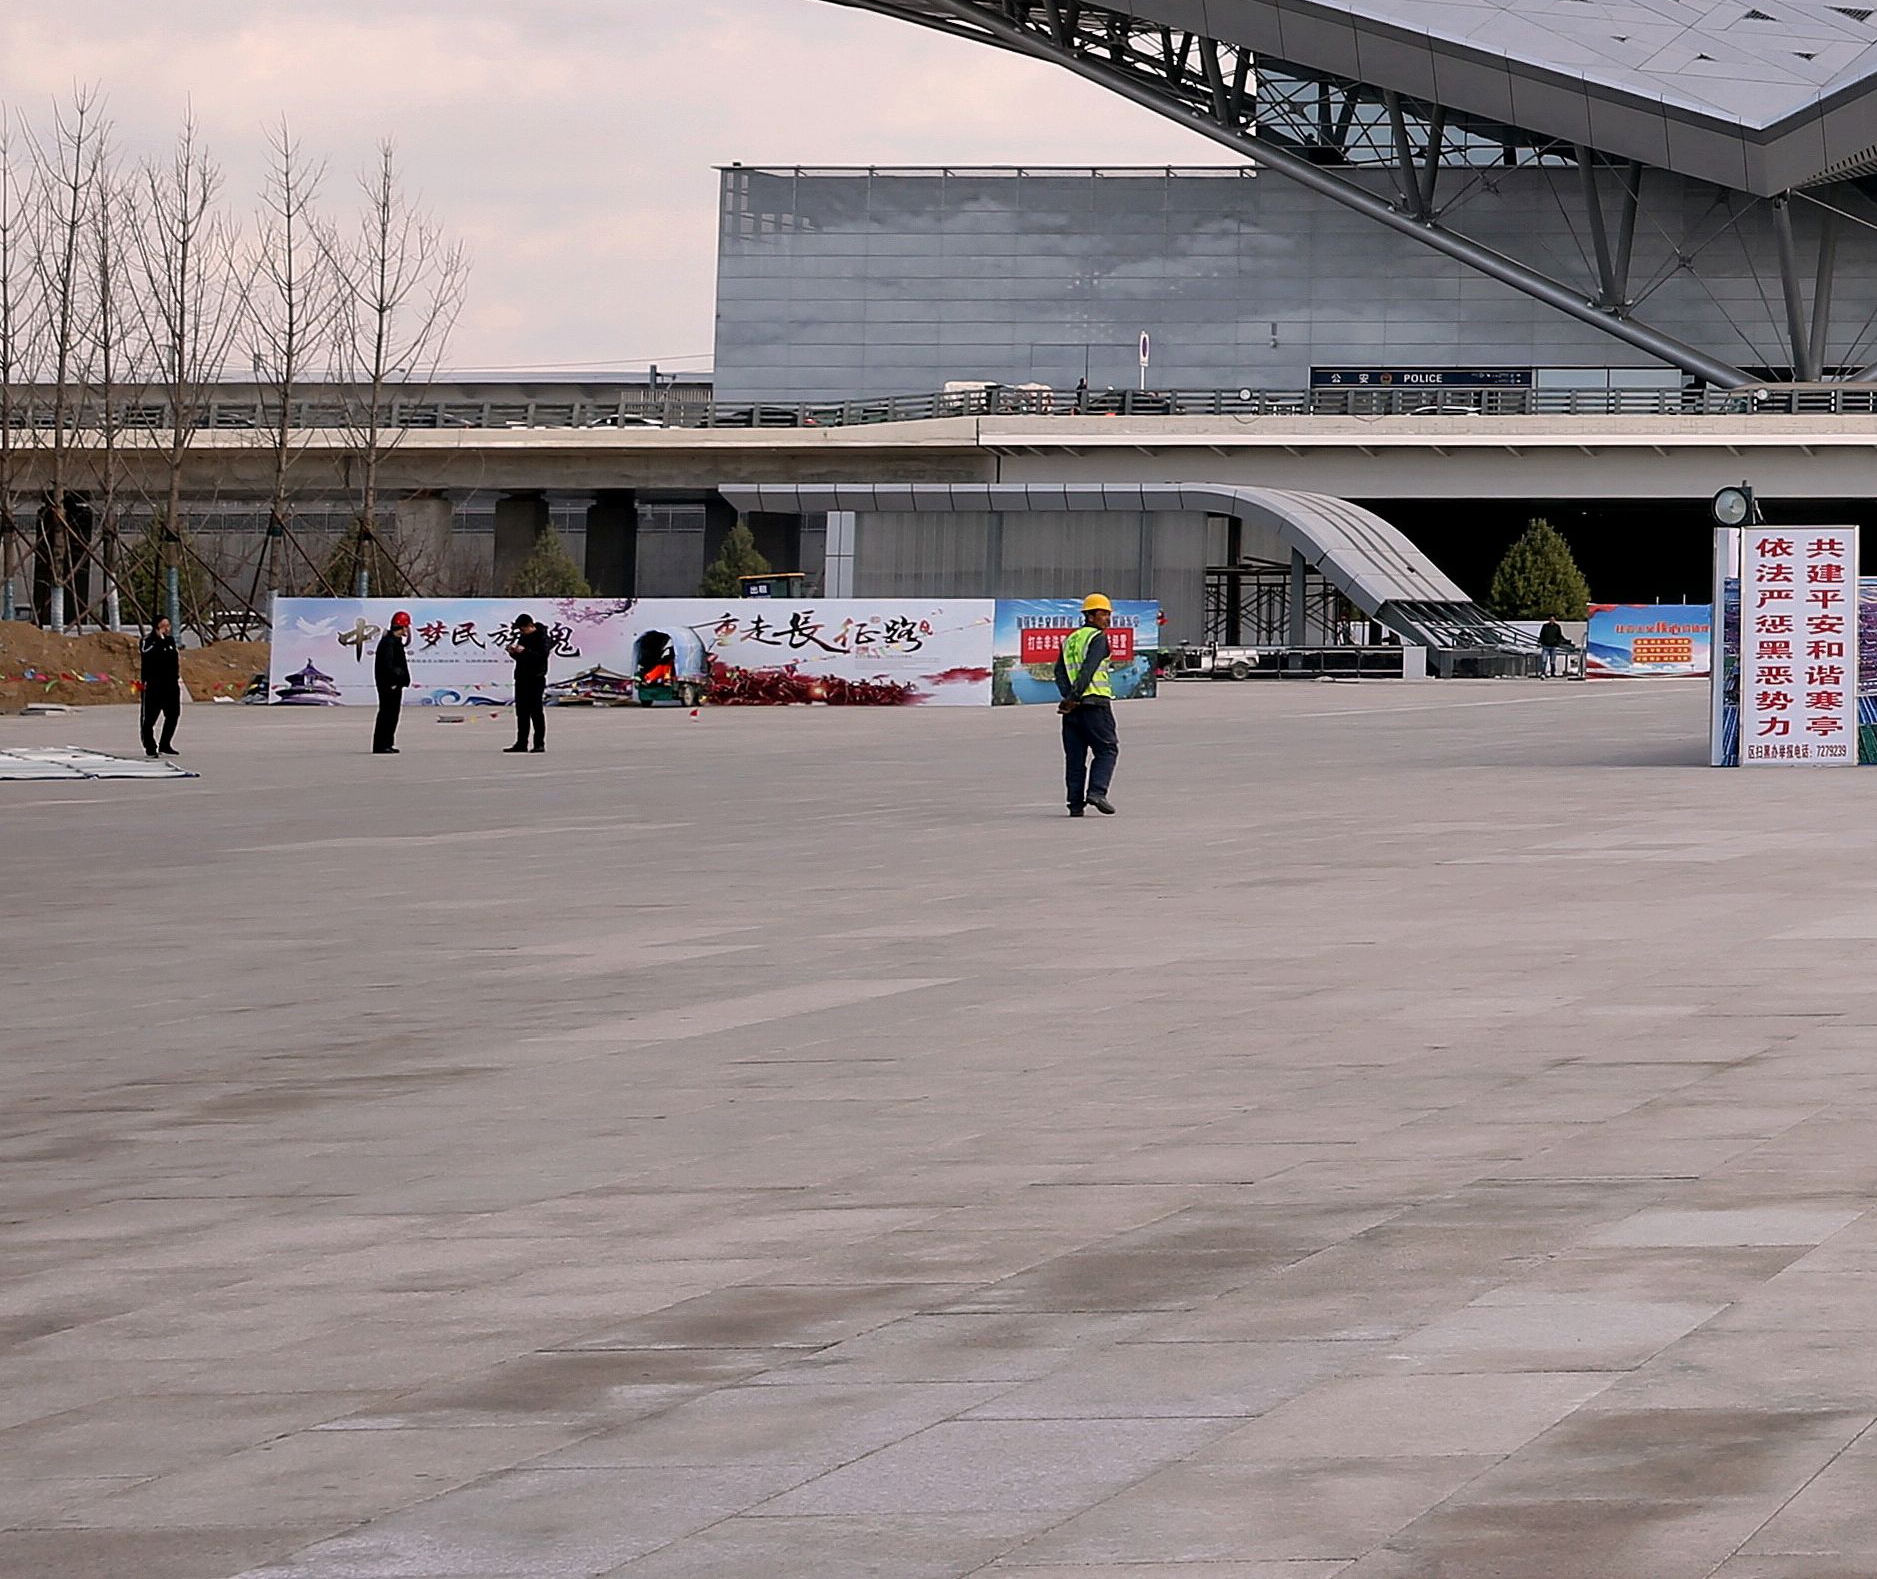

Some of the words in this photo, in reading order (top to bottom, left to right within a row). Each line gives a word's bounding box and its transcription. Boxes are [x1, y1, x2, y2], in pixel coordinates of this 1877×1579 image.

[1331, 373, 1370, 384] 公安
[1403, 373, 1443, 383] POLICE
[337, 617, 581, 663] 中梦民族魂
[1754, 537, 1795, 737] 依法严惩黑恶势力
[1805, 538, 1846, 737] 共建平安和谐寒亭
